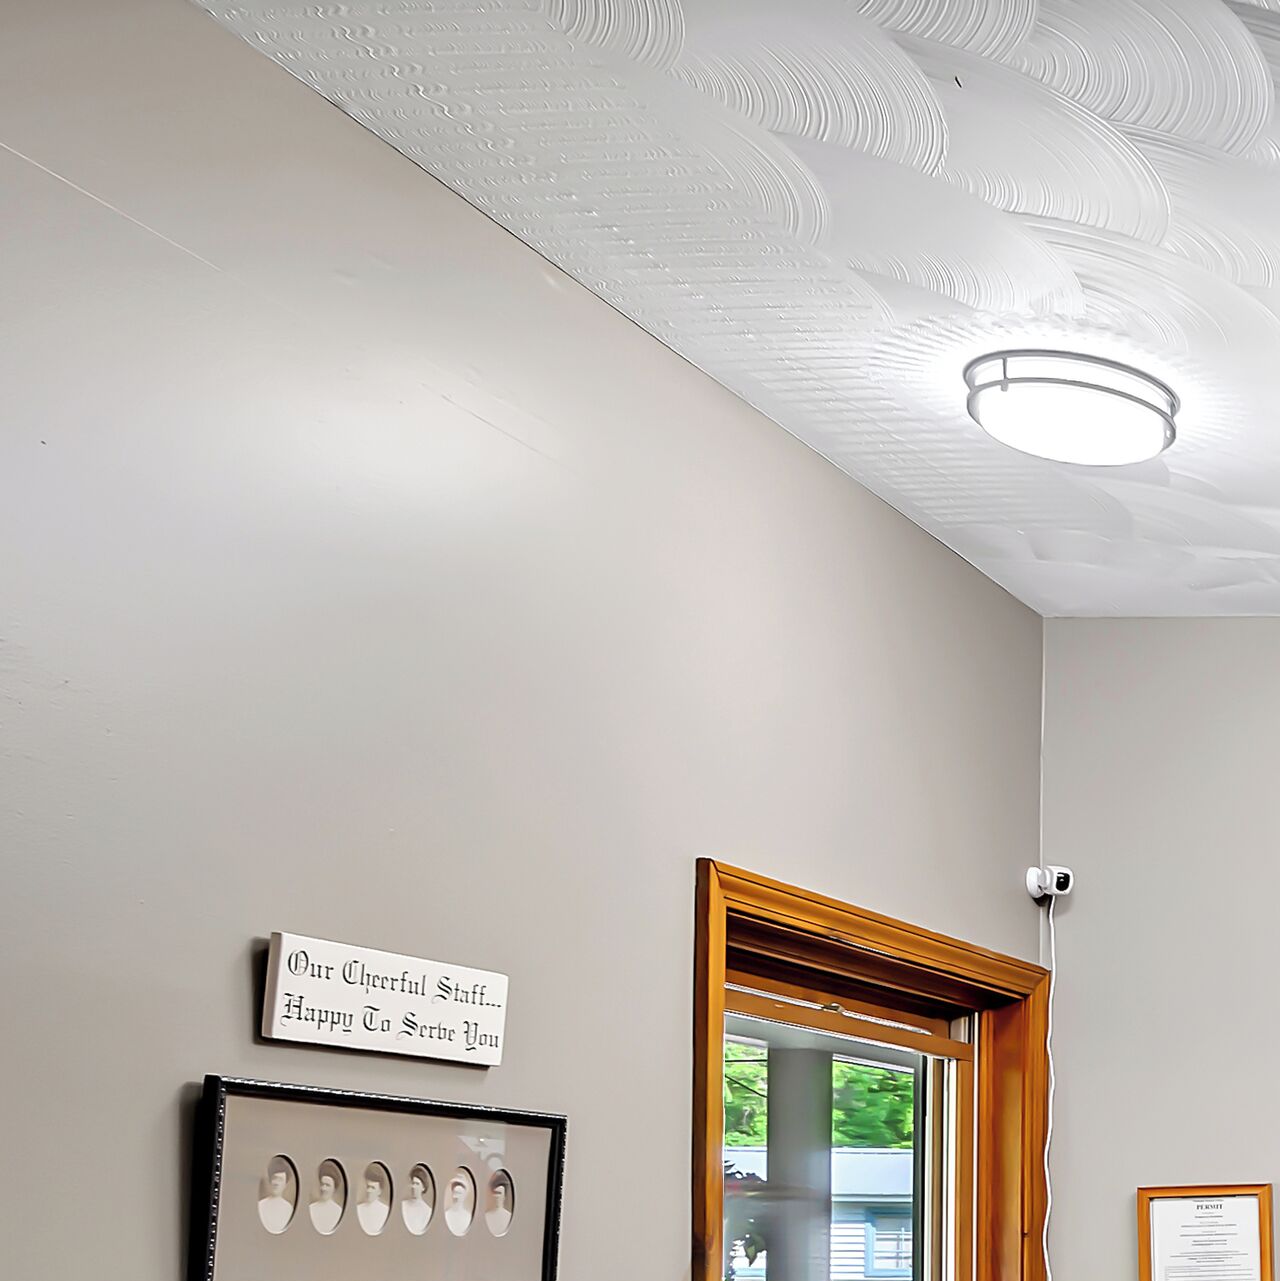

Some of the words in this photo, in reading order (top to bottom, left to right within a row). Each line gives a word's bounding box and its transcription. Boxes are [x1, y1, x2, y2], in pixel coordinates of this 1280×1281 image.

[288, 950, 334, 980] Our
[342, 960, 426, 994] Cheerful
[281, 993, 353, 1034] Happy
[363, 1005, 391, 1032] To
[396, 1011, 456, 1041] Serve
[463, 1021, 499, 1051] You
